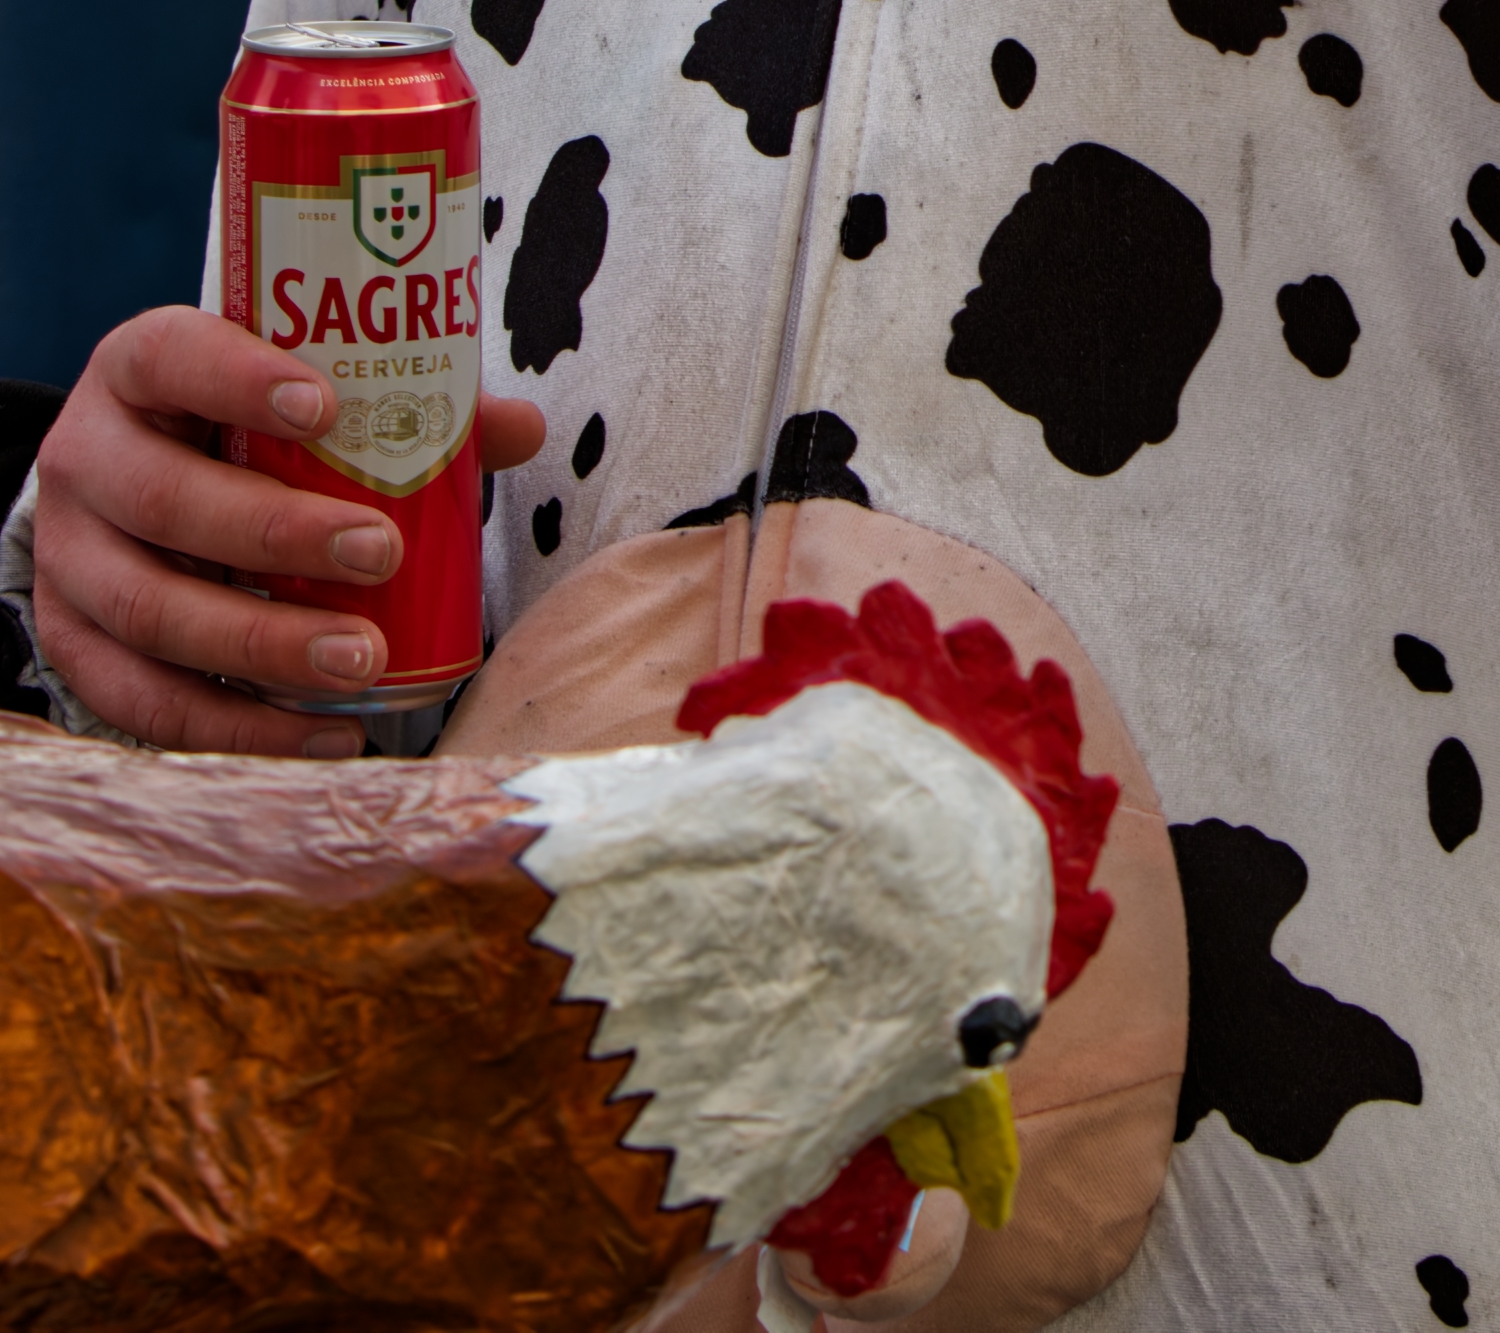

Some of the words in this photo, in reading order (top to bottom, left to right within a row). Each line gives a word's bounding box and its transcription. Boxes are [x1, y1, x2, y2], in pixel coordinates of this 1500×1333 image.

[320, 76, 385, 88] EXCELÊNCIA
[388, 71, 446, 87] COMPROVADA
[297, 211, 338, 222] DESDE
[447, 202, 466, 214] 1940
[270, 254, 480, 351] SAGRES
[331, 352, 454, 380] CERVEJA
